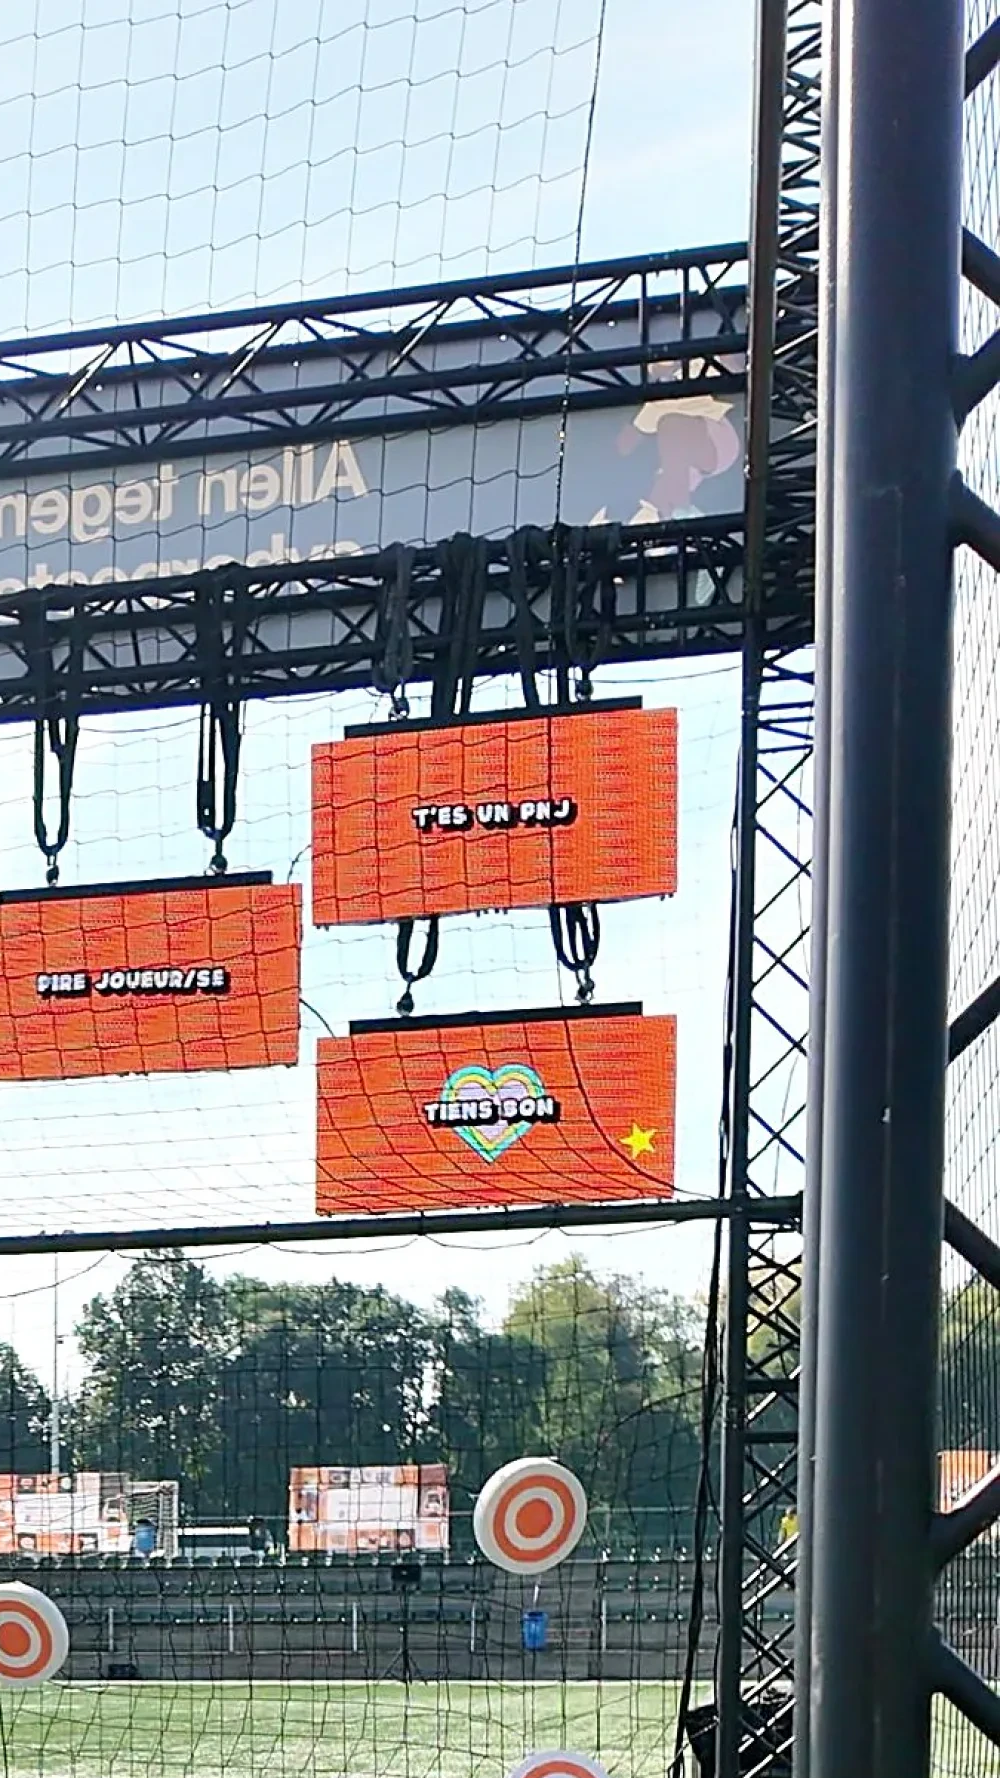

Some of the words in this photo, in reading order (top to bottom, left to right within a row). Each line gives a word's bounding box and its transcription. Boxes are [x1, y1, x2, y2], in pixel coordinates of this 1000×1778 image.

[412, 804, 469, 829] T'ES
[476, 803, 511, 825] UN
[519, 799, 571, 821] PNJ
[37, 972, 87, 993] PIRE
[94, 967, 226, 991] JOUEUR/SE
[423, 1099, 494, 1122] TIENS
[497, 1096, 555, 1119] BON
